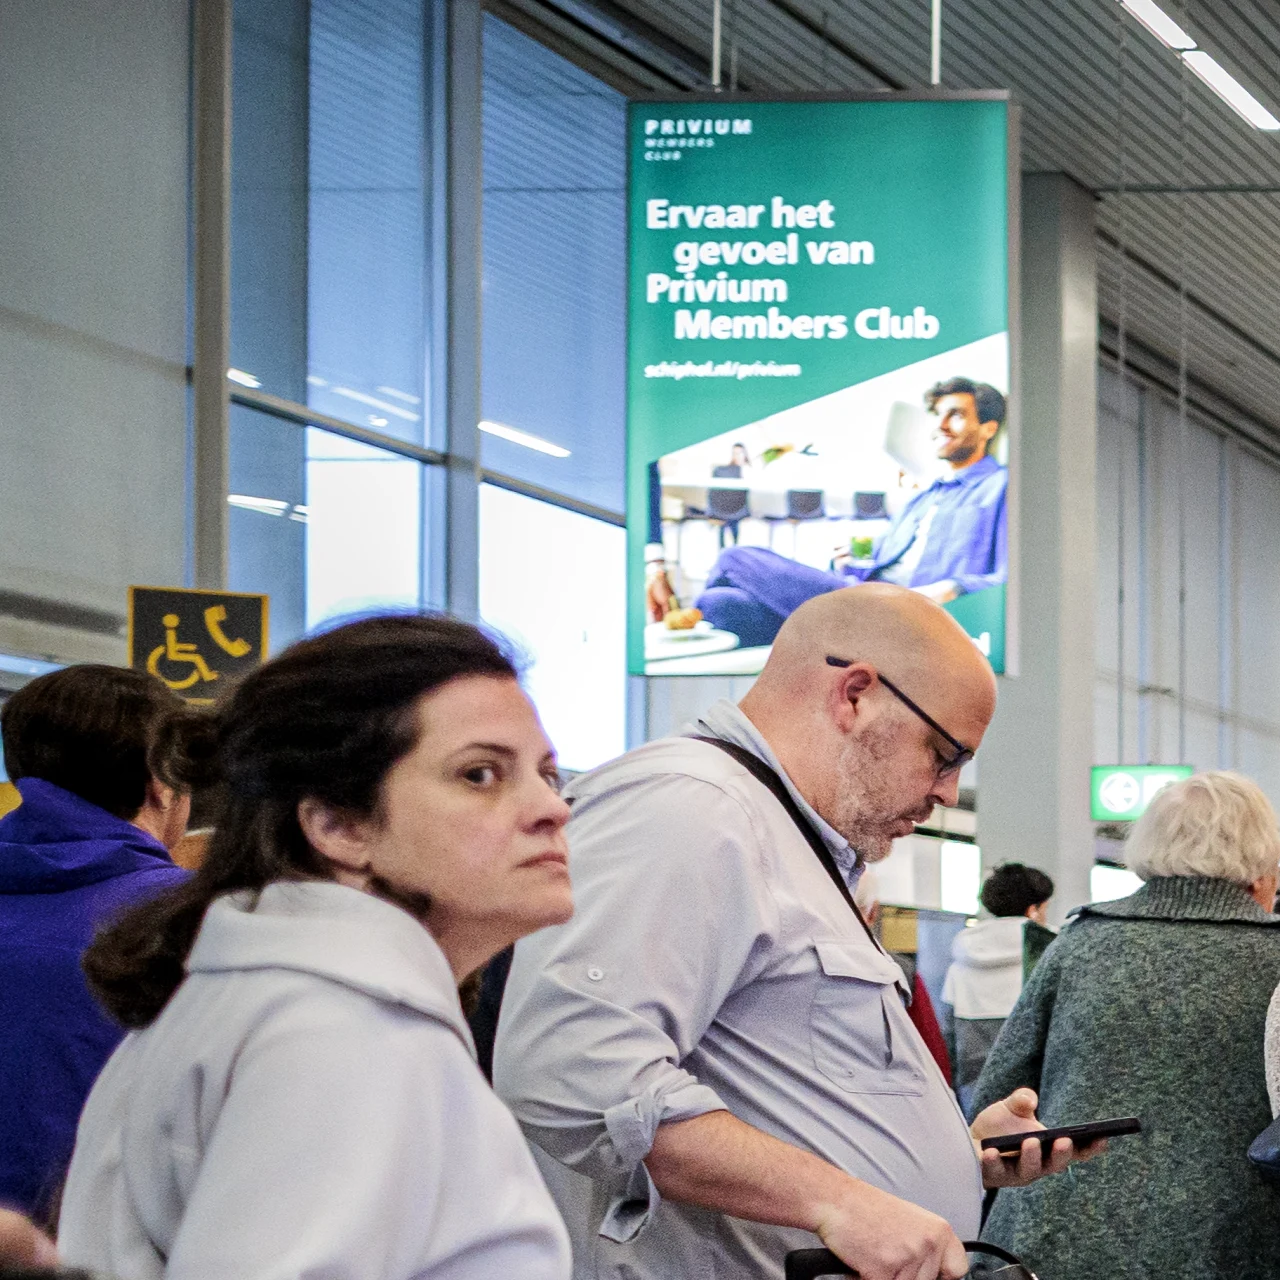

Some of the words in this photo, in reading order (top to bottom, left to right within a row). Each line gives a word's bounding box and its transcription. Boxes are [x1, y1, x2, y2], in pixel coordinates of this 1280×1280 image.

[644, 119, 752, 135] PRIVIUM
[646, 199, 765, 228] Ervaar
[771, 196, 835, 228] het
[674, 233, 798, 272] gevoel
[806, 240, 874, 265] van
[646, 272, 788, 303] Privium
[674, 307, 848, 339] Members
[854, 306, 940, 339] Club
